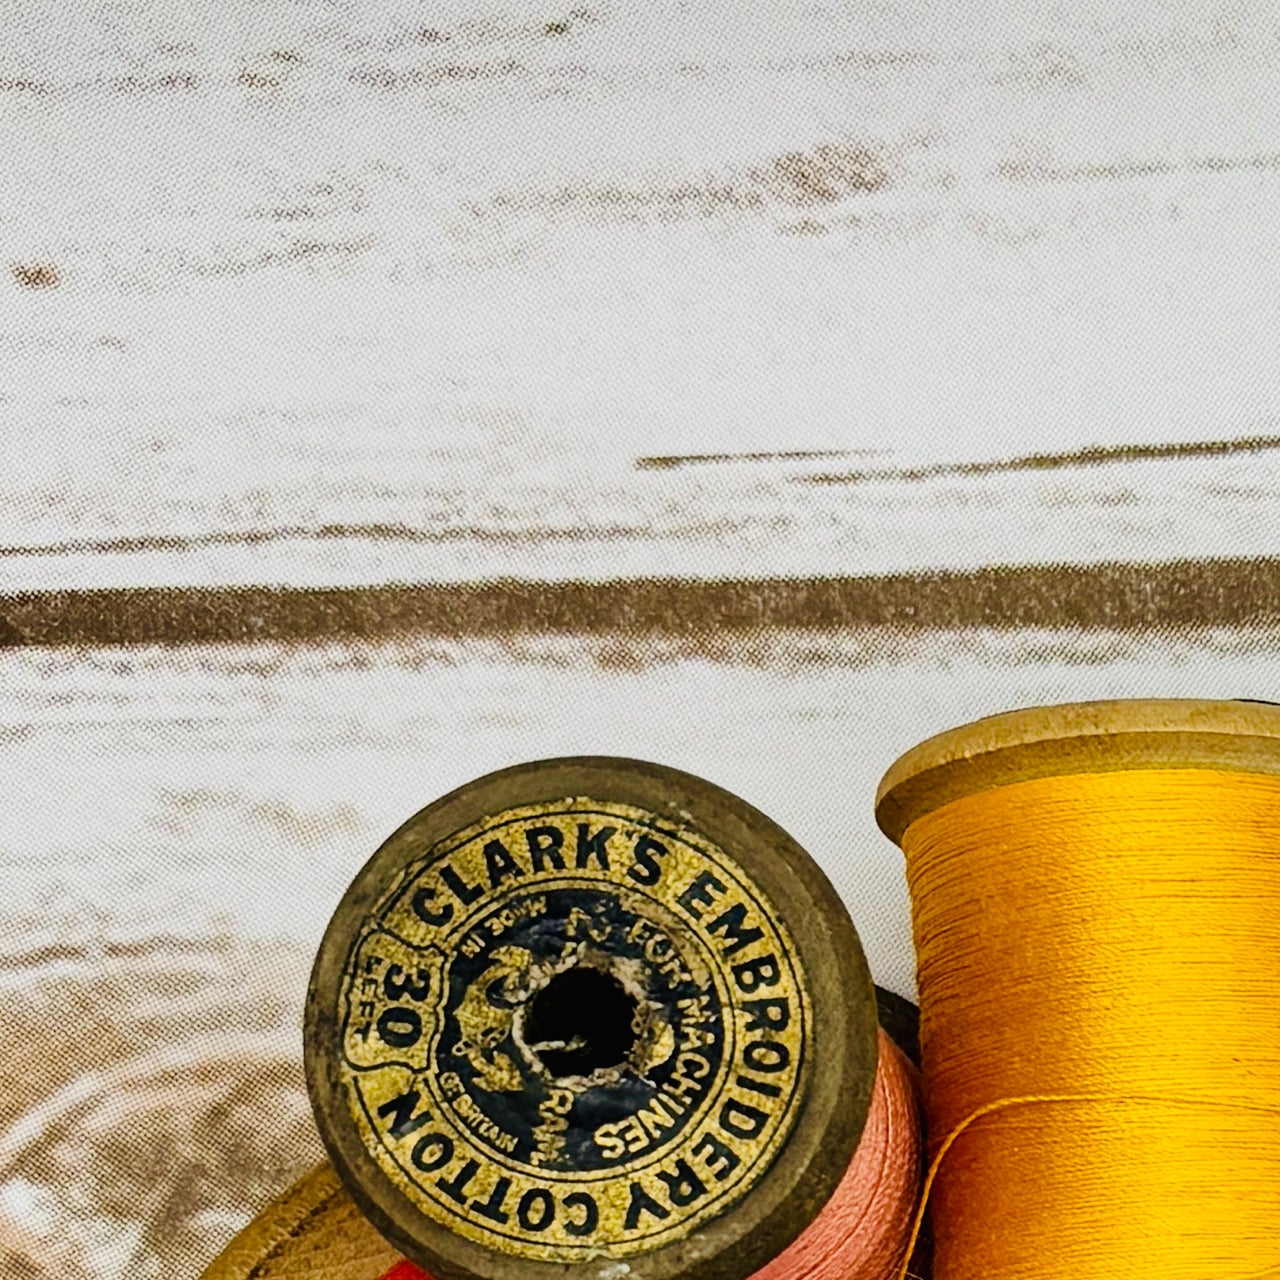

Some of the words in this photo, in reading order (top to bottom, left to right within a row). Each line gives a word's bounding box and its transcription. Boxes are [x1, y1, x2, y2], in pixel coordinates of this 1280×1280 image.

[411, 821, 670, 929] CLARK'S
[376, 963, 432, 1049] 30
[593, 994, 712, 1160] MACHINES
[622, 872, 790, 1233] EMBROIDERY
[377, 1092, 599, 1236] COTTON
